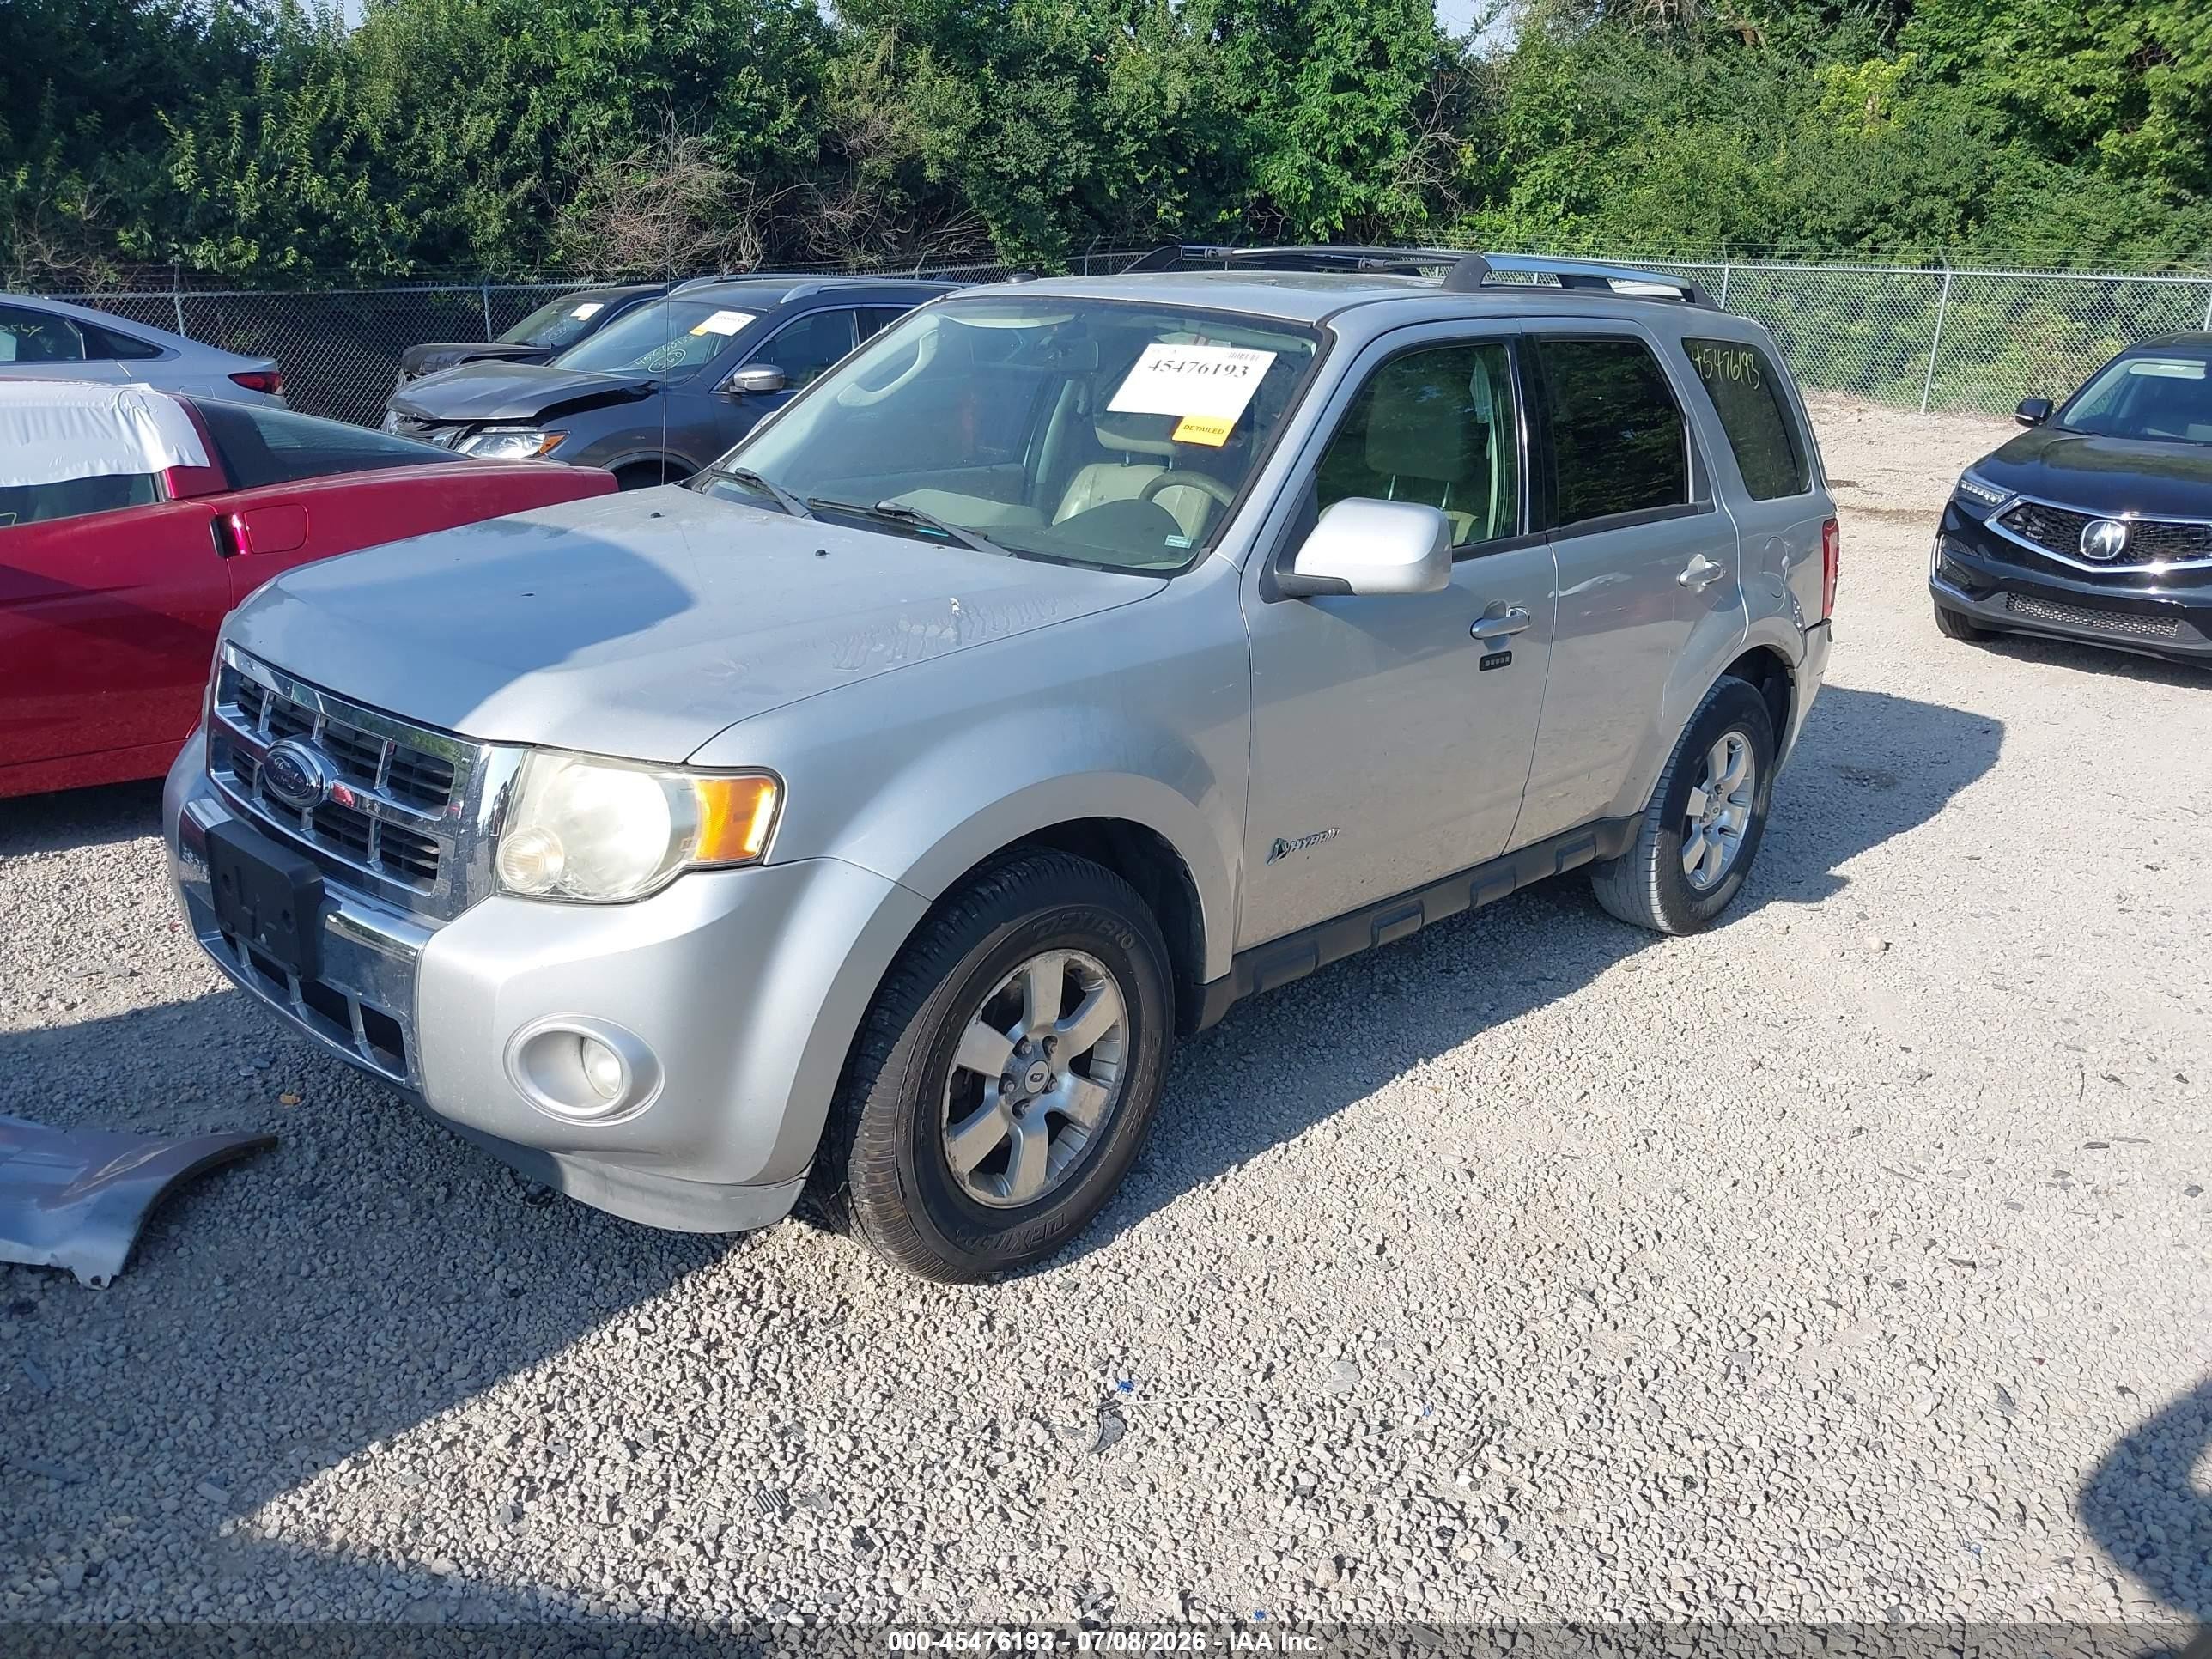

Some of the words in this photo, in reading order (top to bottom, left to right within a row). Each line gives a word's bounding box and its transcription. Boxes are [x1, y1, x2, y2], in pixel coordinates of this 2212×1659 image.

[1148, 359, 1249, 378] 45476193
[1691, 345, 1759, 390] 45476193
[1183, 424, 1224, 434] DETAILED
